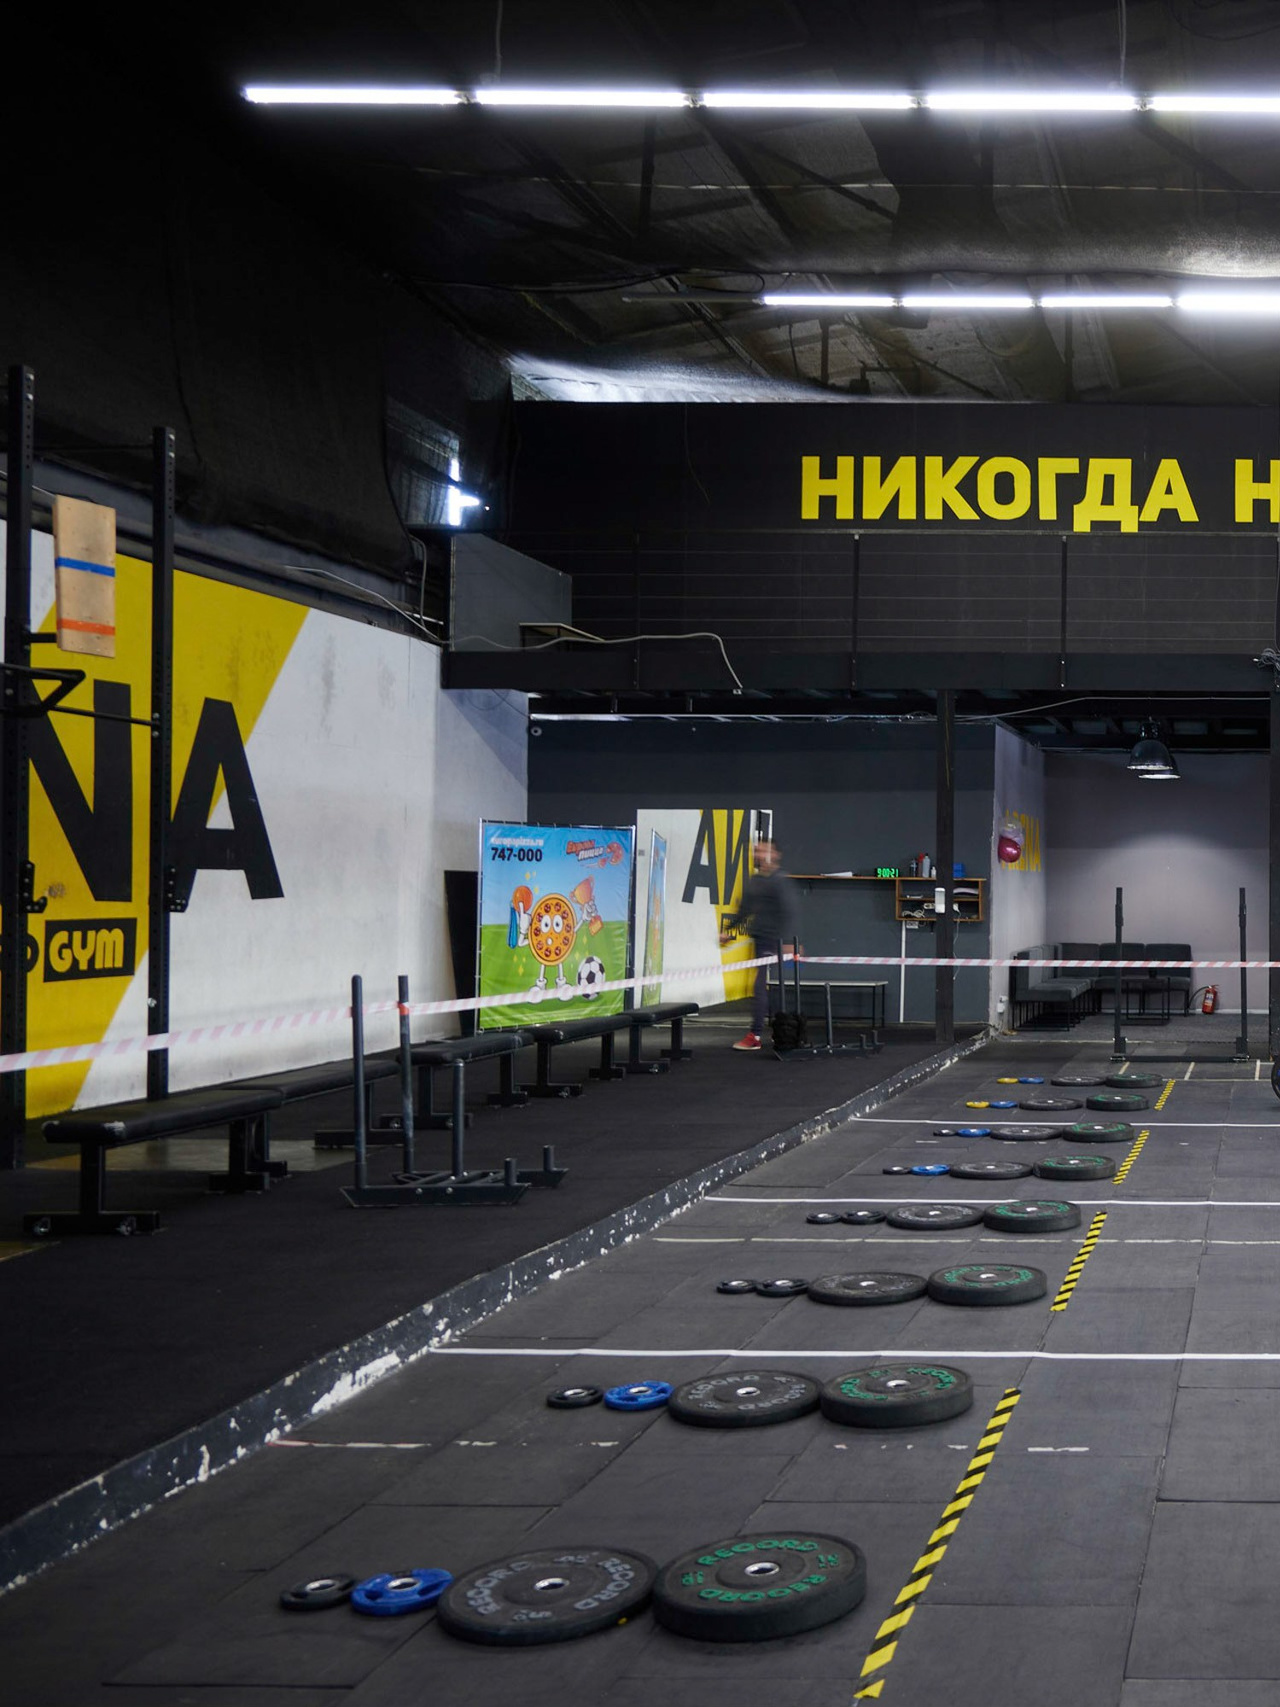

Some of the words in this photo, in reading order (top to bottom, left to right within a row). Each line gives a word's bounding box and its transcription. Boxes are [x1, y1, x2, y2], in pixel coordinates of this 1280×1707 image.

[802, 456, 1199, 534] НИКОГДА
[491, 848, 543, 862] 747-000
[49, 929, 125, 973] GYM
[697, 1539, 819, 1566] RECORD
[465, 1560, 532, 1615] RECORD
[573, 1556, 636, 1611] RECORD
[698, 1573, 827, 1603] RECORD
